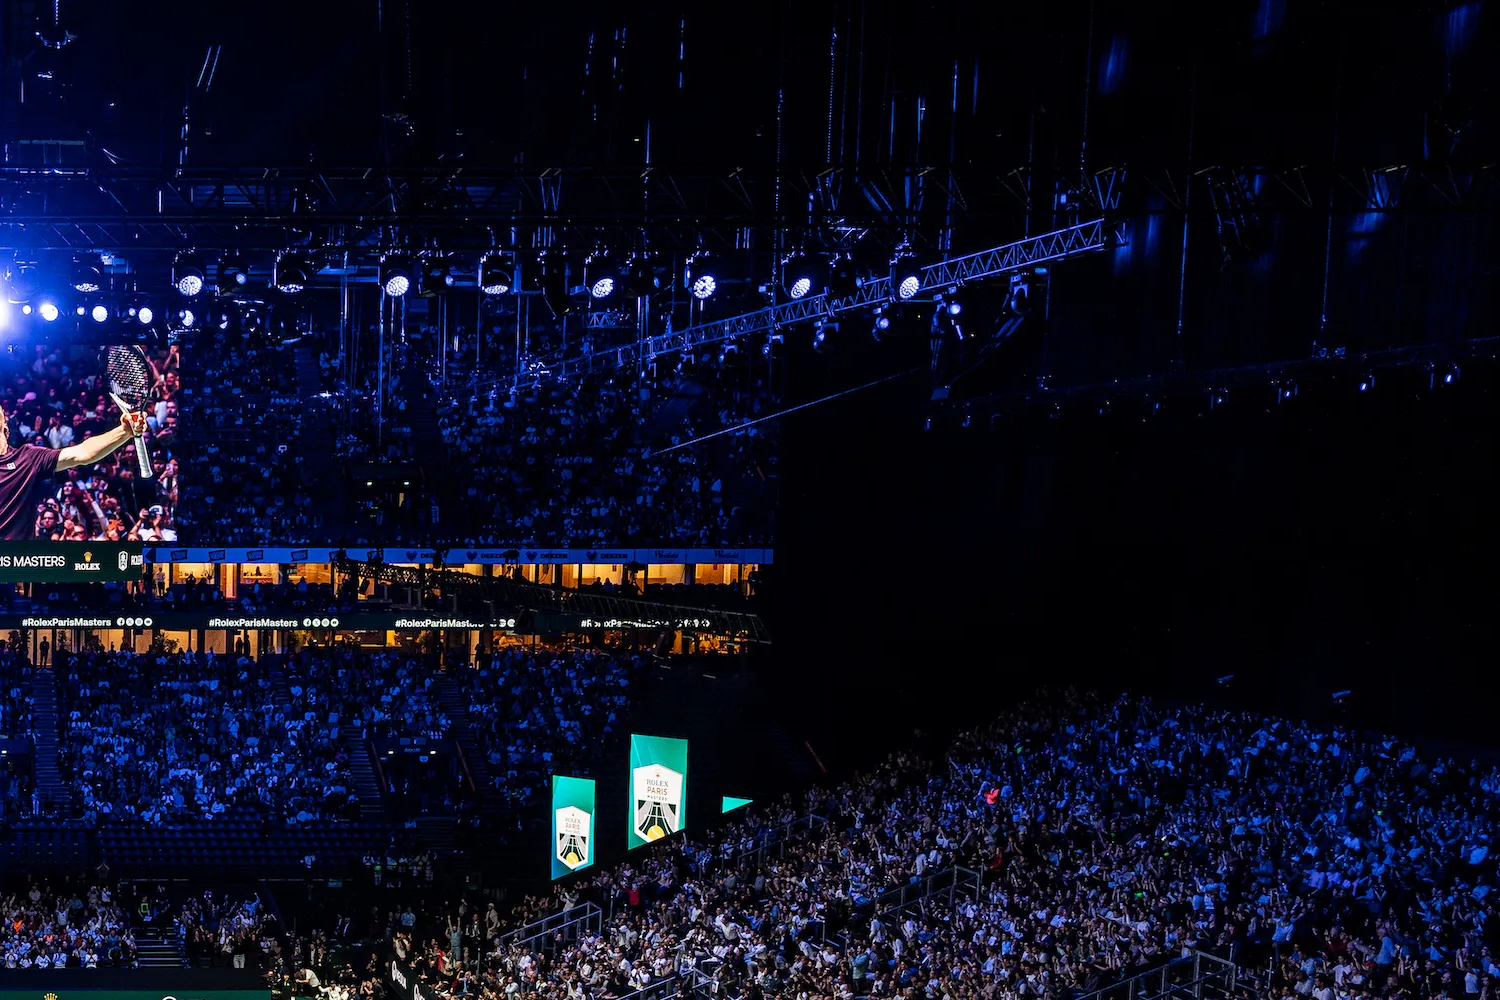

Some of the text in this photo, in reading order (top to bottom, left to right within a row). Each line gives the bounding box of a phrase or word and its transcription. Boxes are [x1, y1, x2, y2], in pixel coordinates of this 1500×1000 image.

[14, 555, 66, 567] MASTERS
[74, 562, 101, 571] ROLEX
[22, 618, 112, 628] #RolexParisMasters
[208, 617, 299, 628] #RolexParisMasters
[646, 779, 669, 787] ROLEX
[646, 786, 668, 796] PARIS
[565, 822, 581, 830] PARIS
